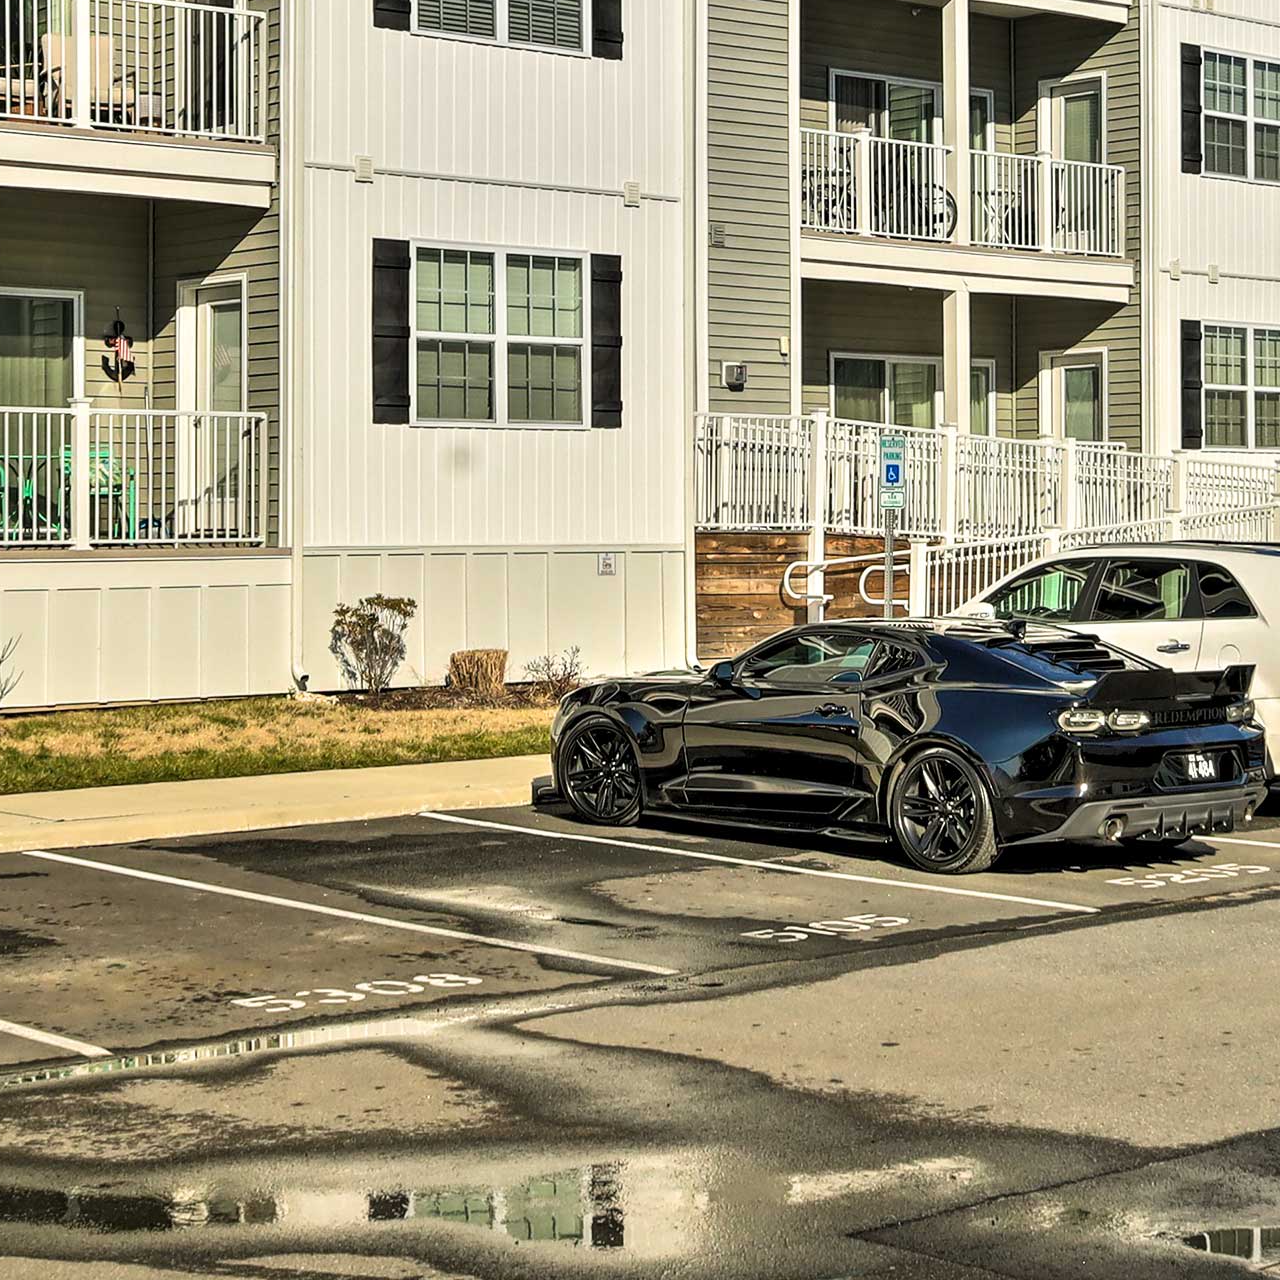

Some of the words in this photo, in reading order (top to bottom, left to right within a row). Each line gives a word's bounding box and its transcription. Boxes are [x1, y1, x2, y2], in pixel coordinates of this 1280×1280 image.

[1154, 705, 1226, 725] REDEMPTION
[1104, 862, 1271, 889] 5205
[739, 913, 910, 943] 5105
[230, 973, 483, 1013] 5308
